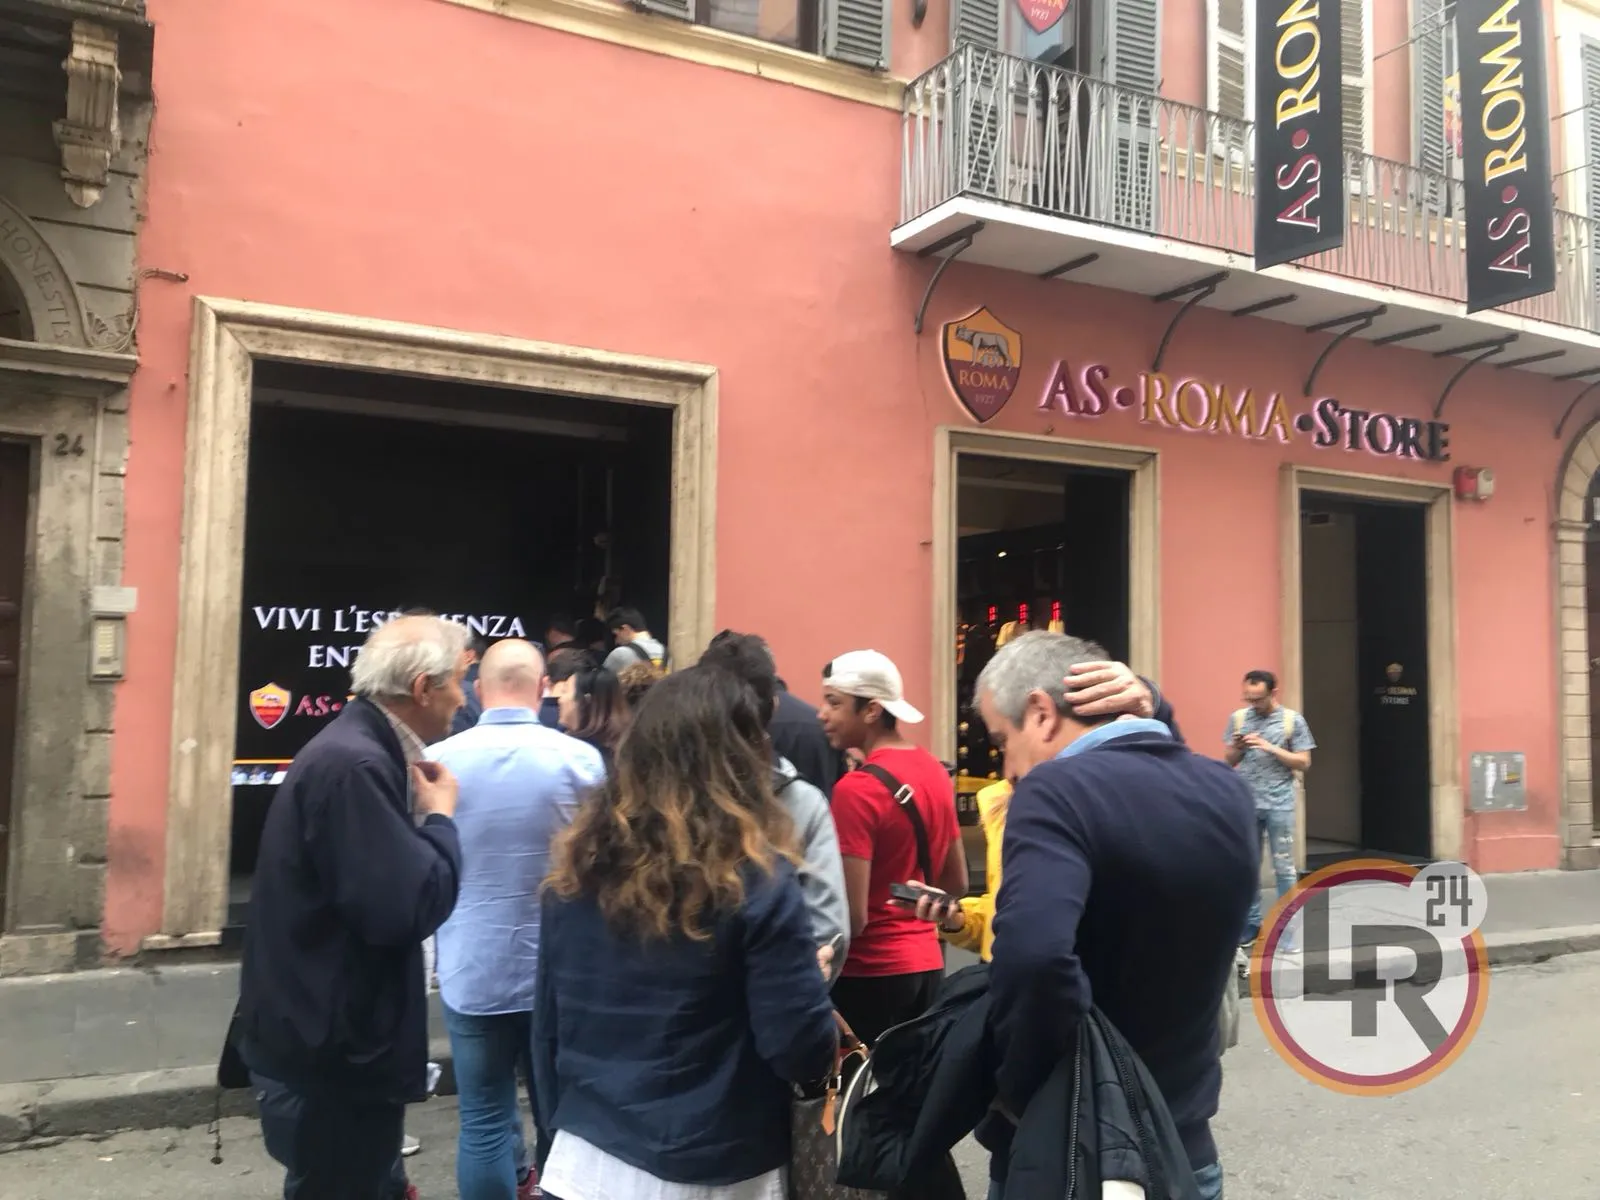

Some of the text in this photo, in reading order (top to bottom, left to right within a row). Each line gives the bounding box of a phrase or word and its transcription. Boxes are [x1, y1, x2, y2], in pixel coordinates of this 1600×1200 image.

[1478, 0, 1531, 279] AS ROMA
[1276, 154, 1321, 233] AS
[959, 371, 1011, 391] ROMA
[1037, 358, 1450, 462] AS ROMA STORE
[54, 433, 85, 457] 24
[252, 606, 321, 631] VIVI
